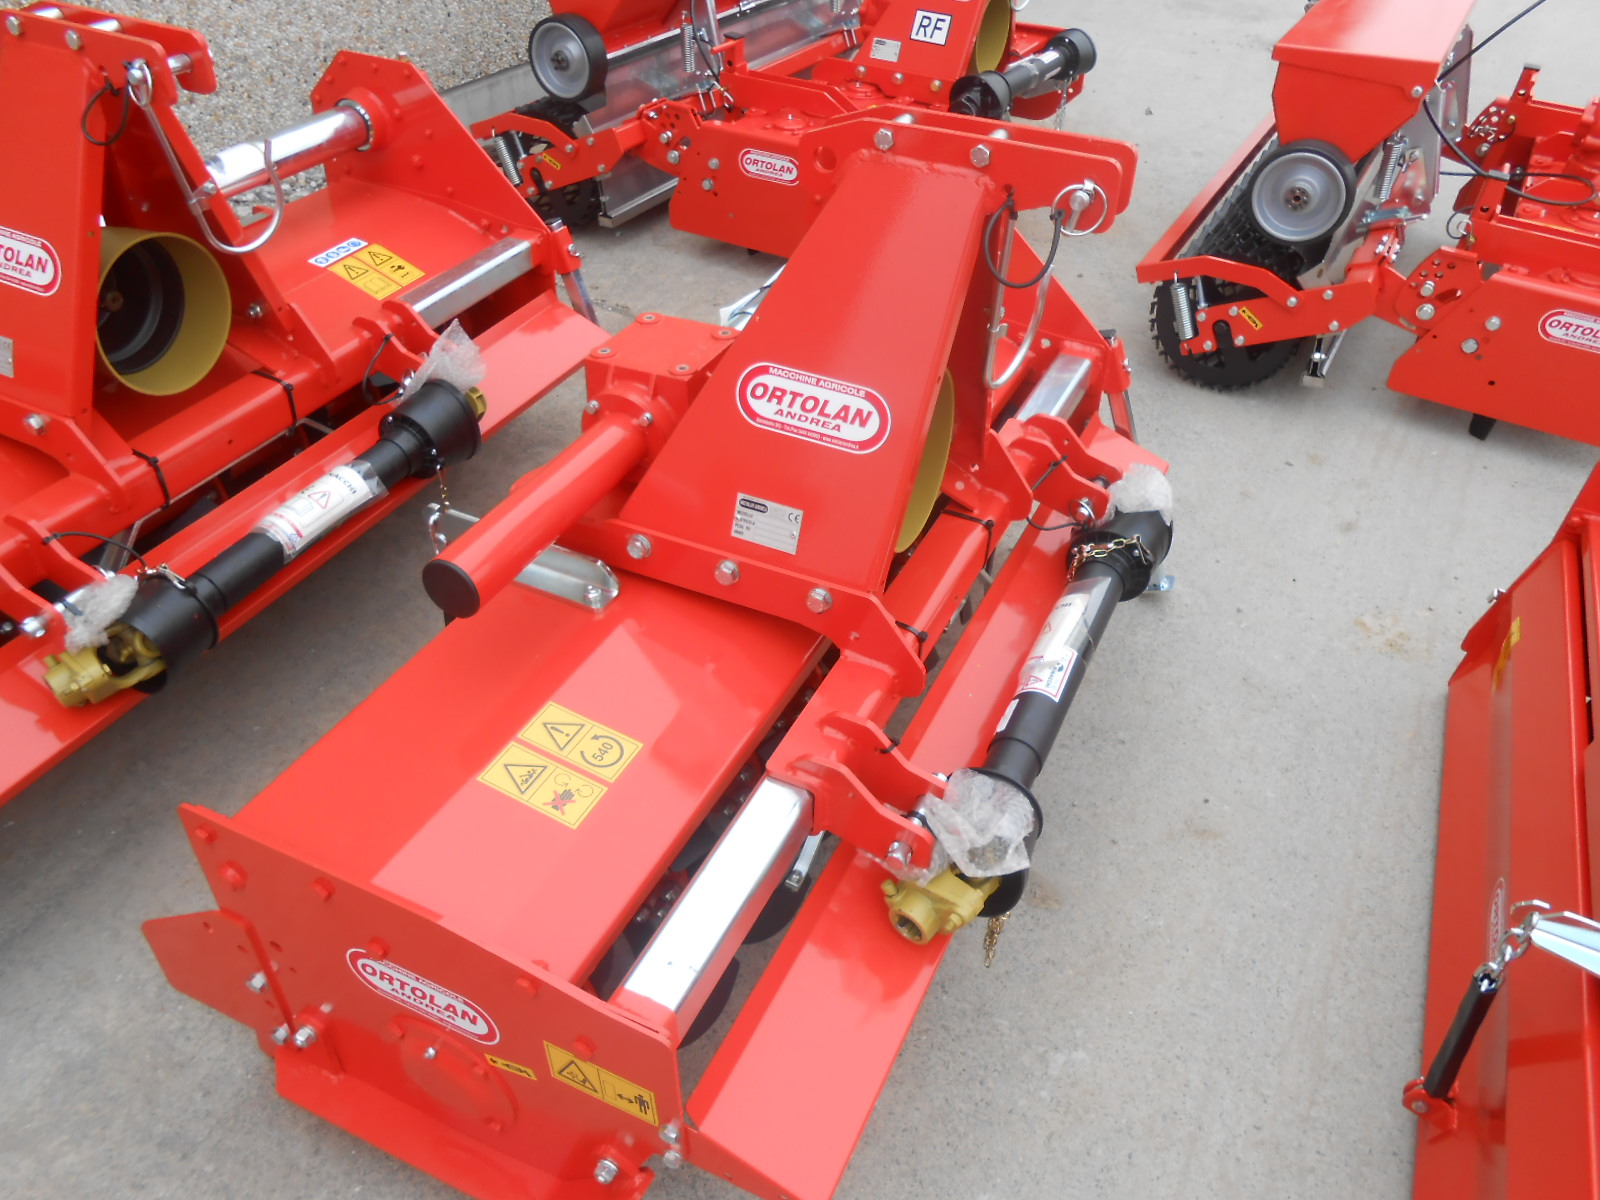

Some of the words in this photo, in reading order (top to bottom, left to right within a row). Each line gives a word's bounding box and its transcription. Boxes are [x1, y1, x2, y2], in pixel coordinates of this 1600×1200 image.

[915, 15, 946, 38] RF
[745, 157, 794, 175] ORTOLAN
[768, 366, 818, 385] MACCHINE
[818, 379, 866, 398] AGRICOLE
[750, 382, 873, 429] ORTOLAN
[774, 408, 841, 433] ANDREA
[592, 742, 613, 762] 540
[361, 963, 479, 1026] ORTOLAN
[390, 988, 456, 1022] ANDREA
